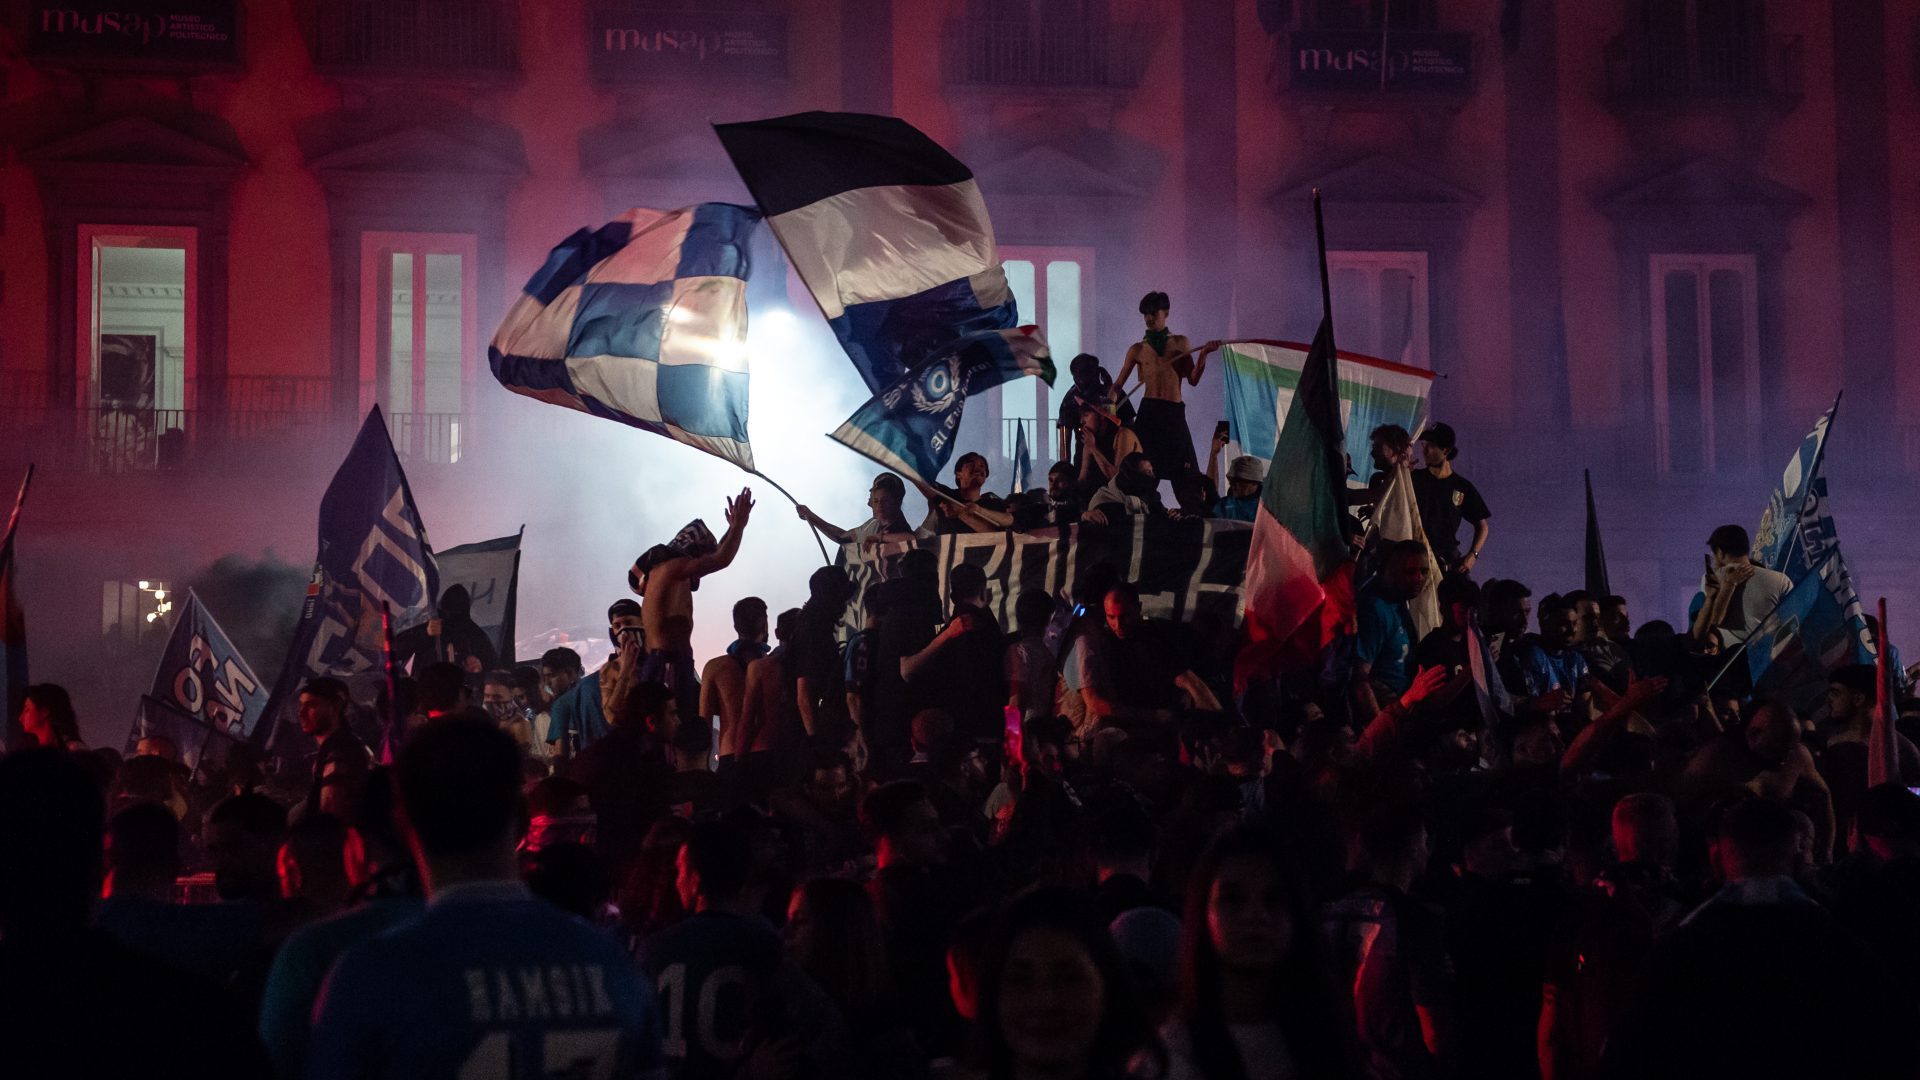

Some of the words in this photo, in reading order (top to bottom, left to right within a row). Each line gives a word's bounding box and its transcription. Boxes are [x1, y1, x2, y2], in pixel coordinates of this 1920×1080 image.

[42, 8, 167, 46] musap
[169, 14, 201, 23] MUSEO
[169, 22, 216, 32] ARTISTICO
[169, 31, 228, 41] POLITECNICO
[605, 28, 721, 61] musap
[1300, 48, 1410, 80] musap
